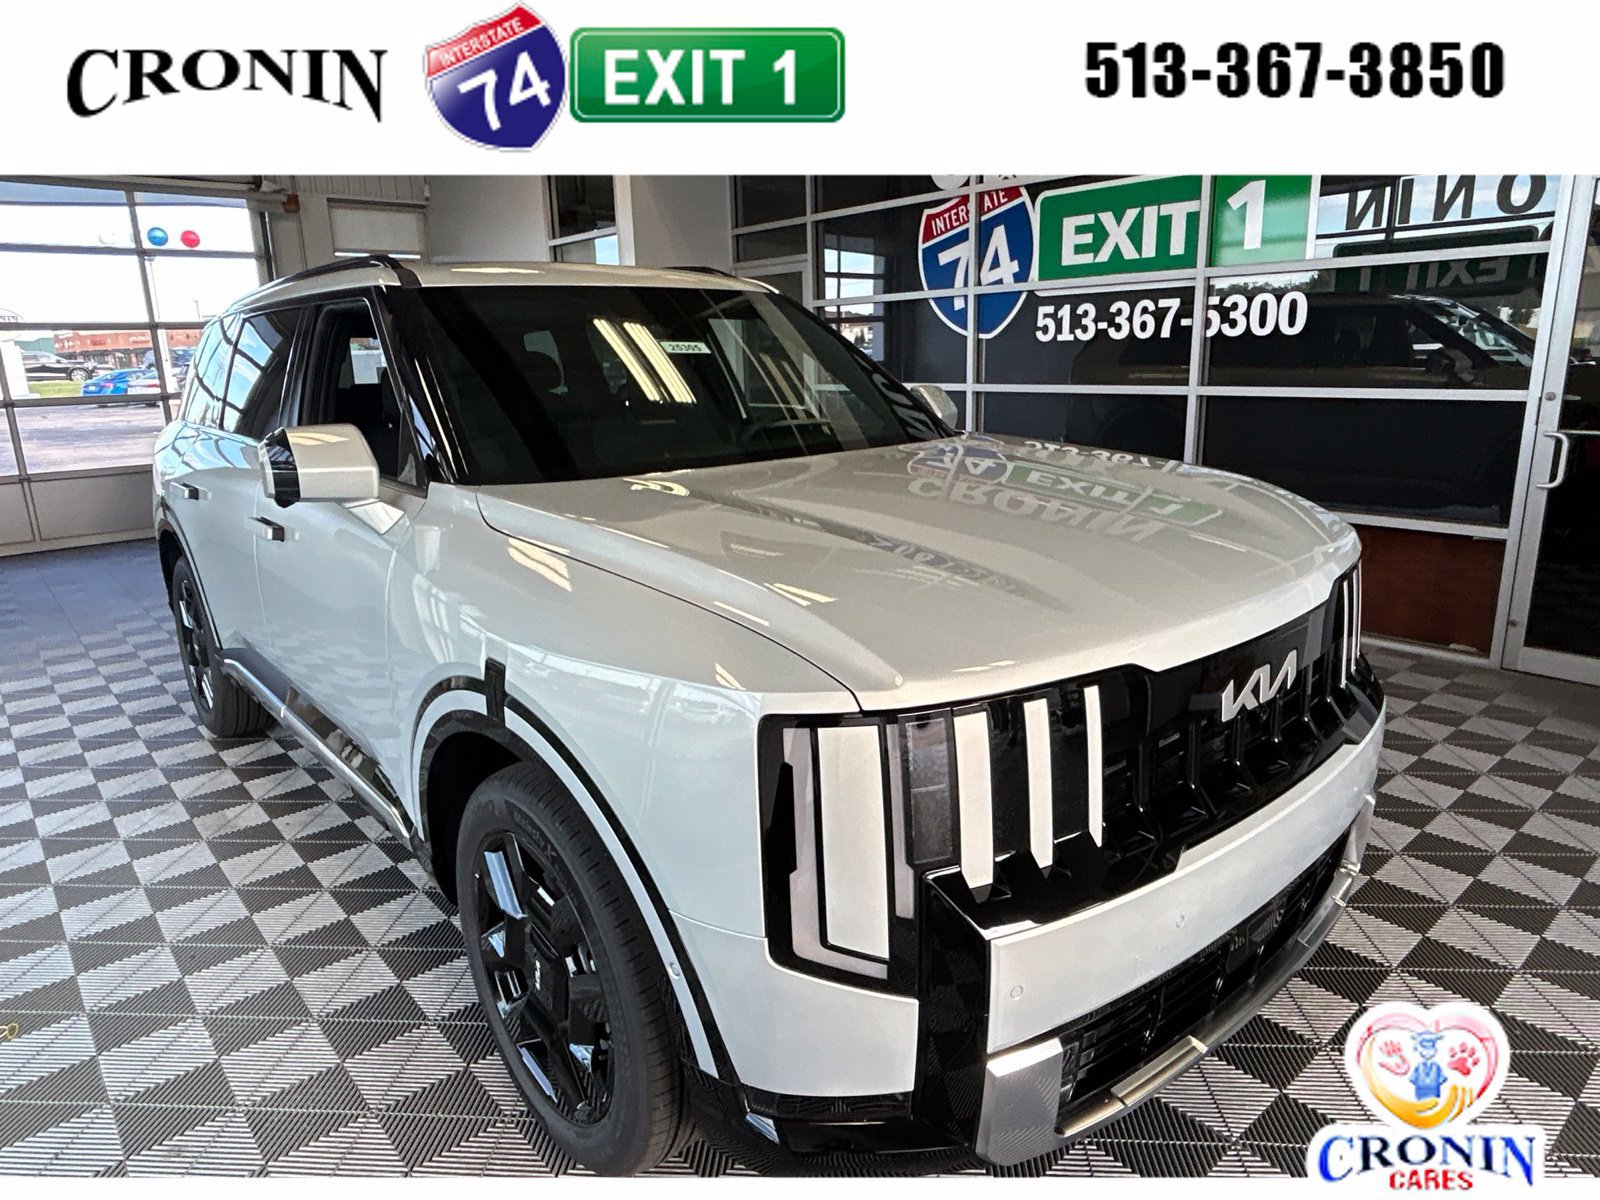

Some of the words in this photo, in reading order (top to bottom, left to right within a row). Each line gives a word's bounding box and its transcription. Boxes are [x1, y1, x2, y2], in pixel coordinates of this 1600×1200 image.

[931, 189, 1018, 236] INTERATE
[1061, 199, 1199, 266] EXIT
[1227, 179, 1266, 250] 1
[937, 224, 1020, 311] 74
[1035, 291, 1308, 342] 513-367-5300
[1221, 649, 1298, 723] KIA
